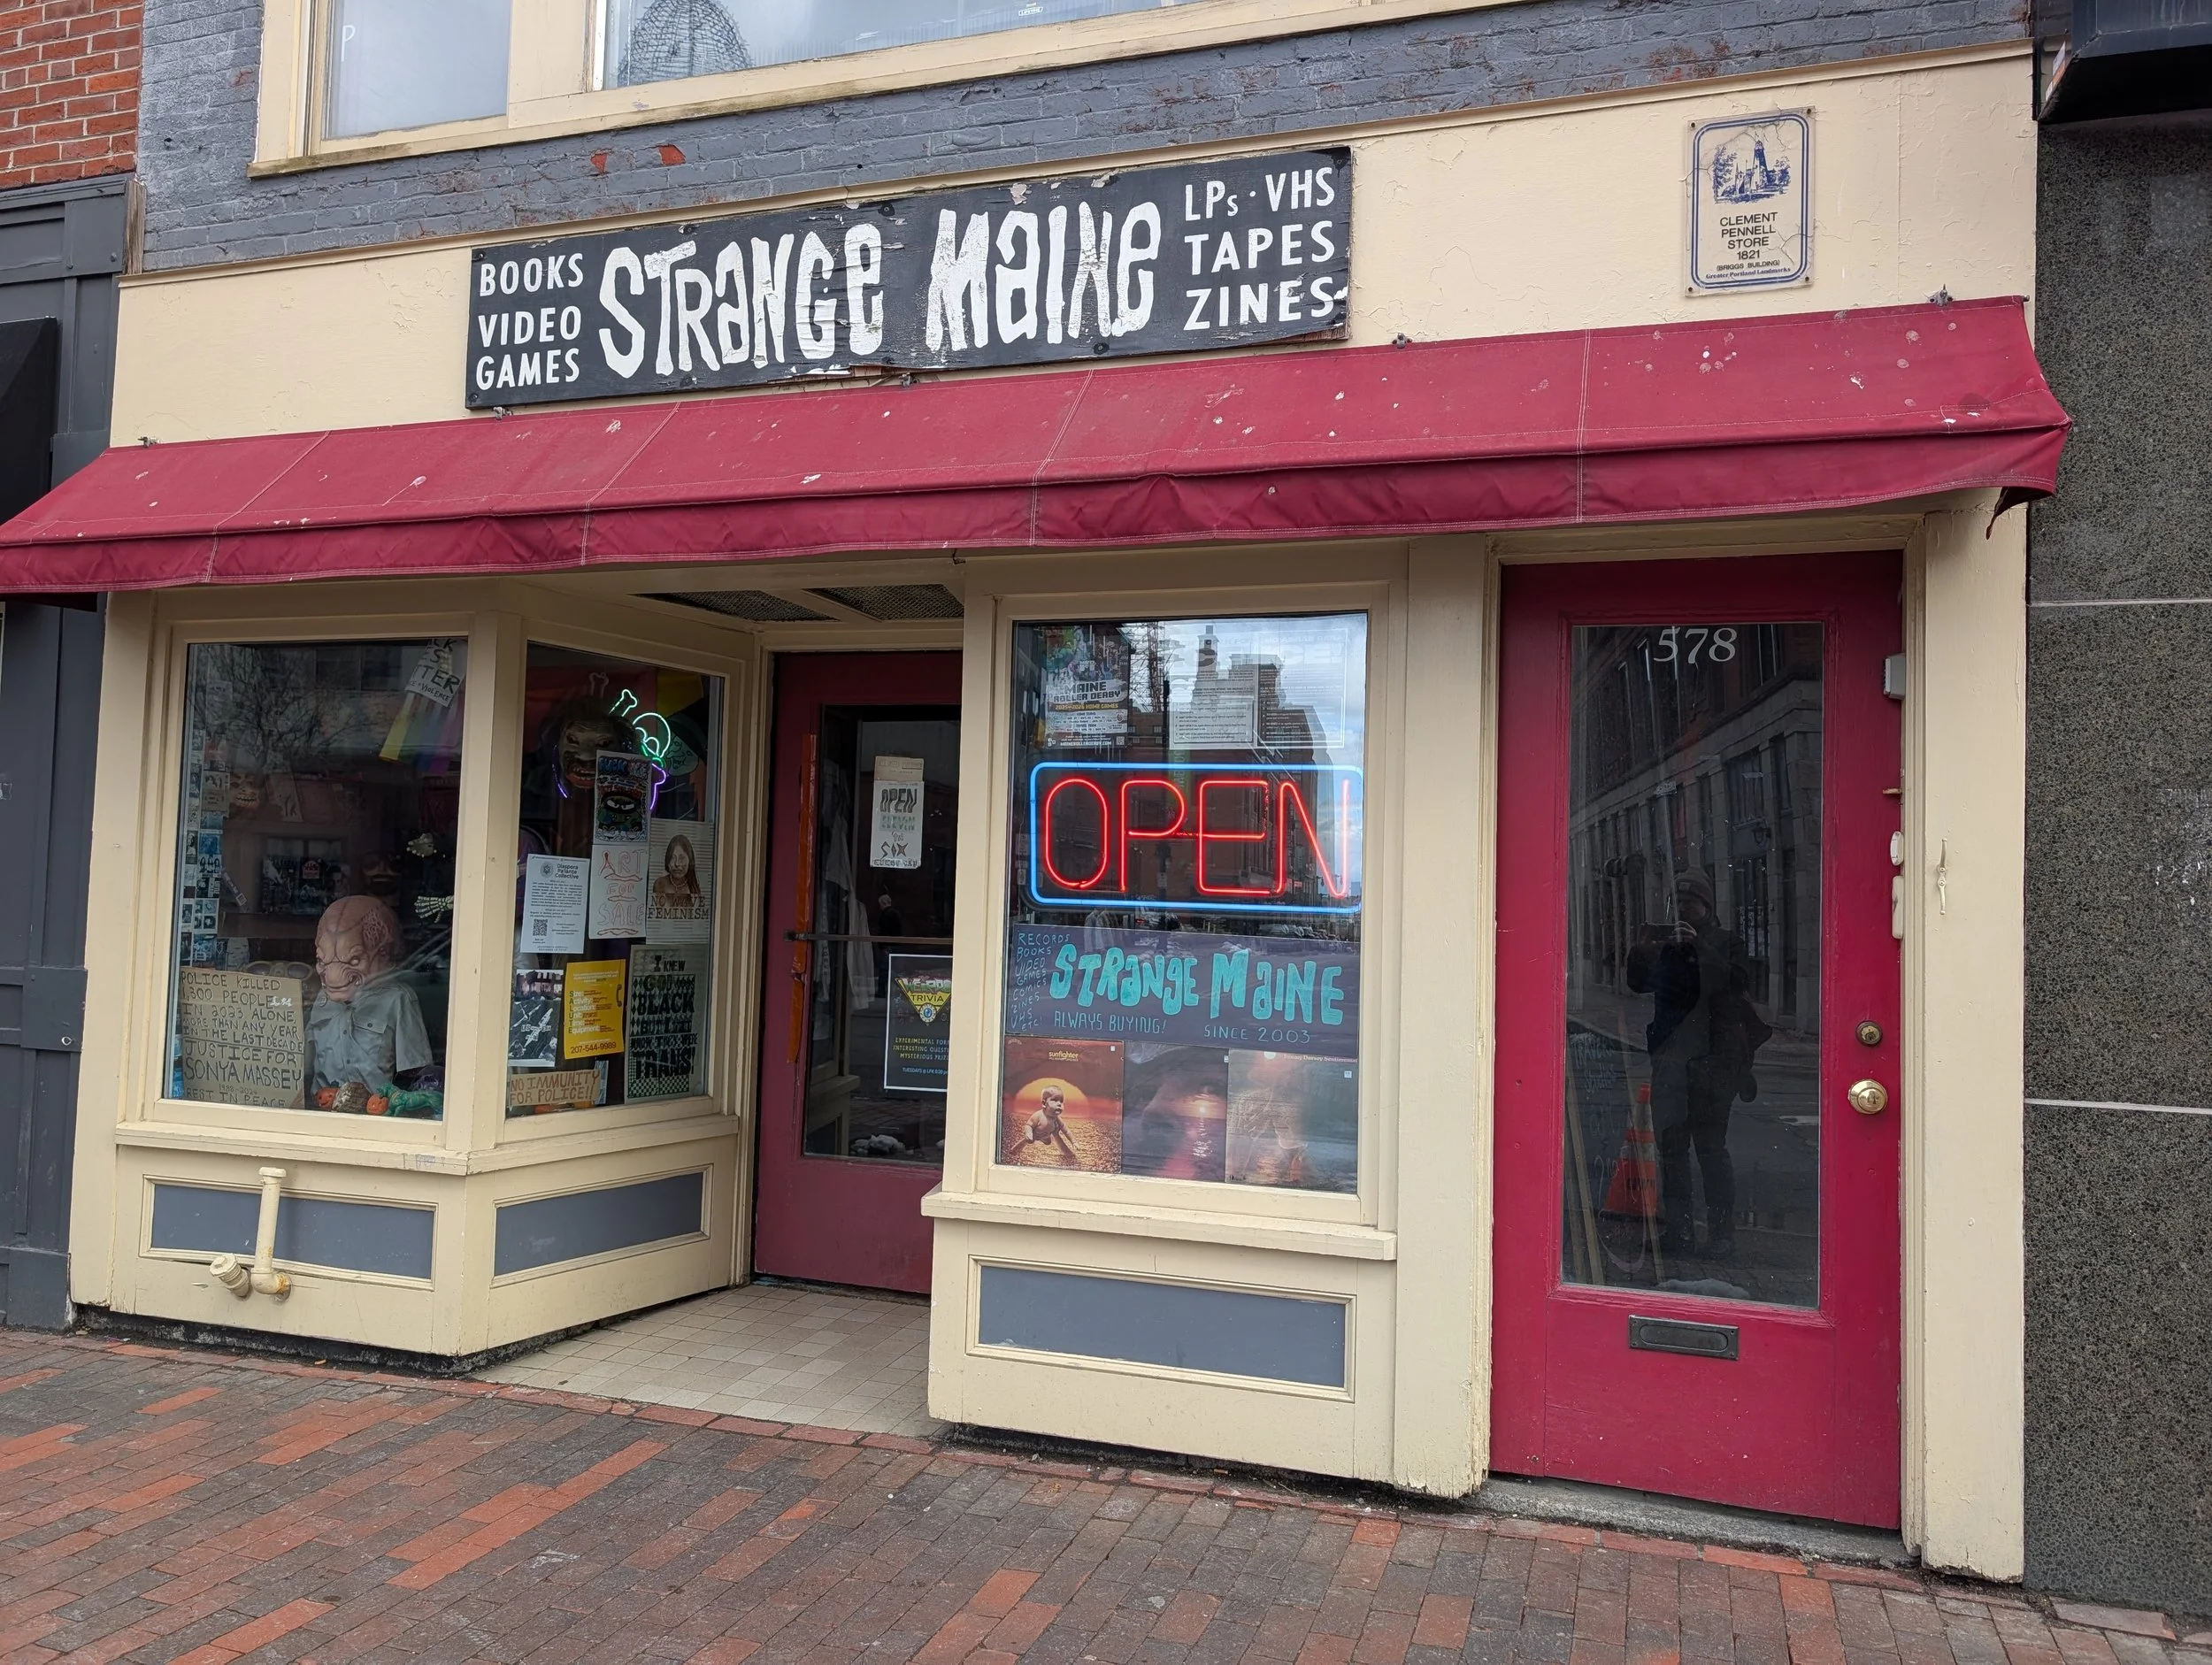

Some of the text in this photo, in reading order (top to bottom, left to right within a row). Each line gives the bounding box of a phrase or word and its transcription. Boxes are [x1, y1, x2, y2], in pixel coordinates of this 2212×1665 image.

[1185, 166, 1335, 221] LPs VHS
[1719, 211, 1778, 226] CLEMENT
[1721, 224, 1776, 238] PENNELL
[1185, 220, 1335, 275] TAPES
[1727, 236, 1770, 249] STORE
[1737, 249, 1760, 260] 1821
[479, 253, 584, 296] BOOKS
[1757, 266, 1791, 275] Landmarks
[1183, 275, 1334, 331] ZINES
[478, 305, 581, 348] VIDEO
[476, 348, 580, 391] GAMES
[1654, 627, 1737, 664] 578
[1053, 690, 1121, 703] ROLLER DERBY
[1064, 681, 1107, 694] MAINE
[880, 788, 918, 813] OPEN
[1044, 777, 1351, 899] OPEN
[880, 841, 909, 859] SIX
[650, 895, 666, 907] NO
[596, 902, 644, 926] SALE
[648, 908, 710, 920] FEMINISM
[1018, 933, 1071, 946] RECORDS
[1017, 947, 1052, 963] BOOKS
[664, 960, 686, 972] KNEW
[1016, 957, 1045, 977] VIDEO
[181, 971, 280, 991] POLICE KILLED
[1017, 968, 1047, 986] GAMES
[181, 986, 274, 1009] 1,300 PEOPLE
[637, 991, 695, 1016] BLACK
[910, 994, 944, 1003] TRIVIA
[182, 1002, 297, 1024] IN 2023 ALONE,
[1011, 1008, 1033, 1029] VHS
[1054, 1010, 1167, 1034] ALWAYS BUYING!
[182, 1017, 300, 1040] MORE THAN ANY YEAR
[183, 1026, 303, 1052] IN THE LAST DECADE
[1203, 1024, 1311, 1045] SINCE 2003
[185, 1040, 297, 1069] JUSTICE FOR
[634, 1046, 696, 1080] TRANS!
[1048, 1050, 1079, 1059] sunfighter
[184, 1056, 302, 1091] SONYA MASSEY
[511, 1070, 601, 1092] NO IMMUNITY
[187, 1087, 214, 1100] REST
[219, 1091, 238, 1104] IN
[510, 1086, 595, 1105] FOR POLICE!!
